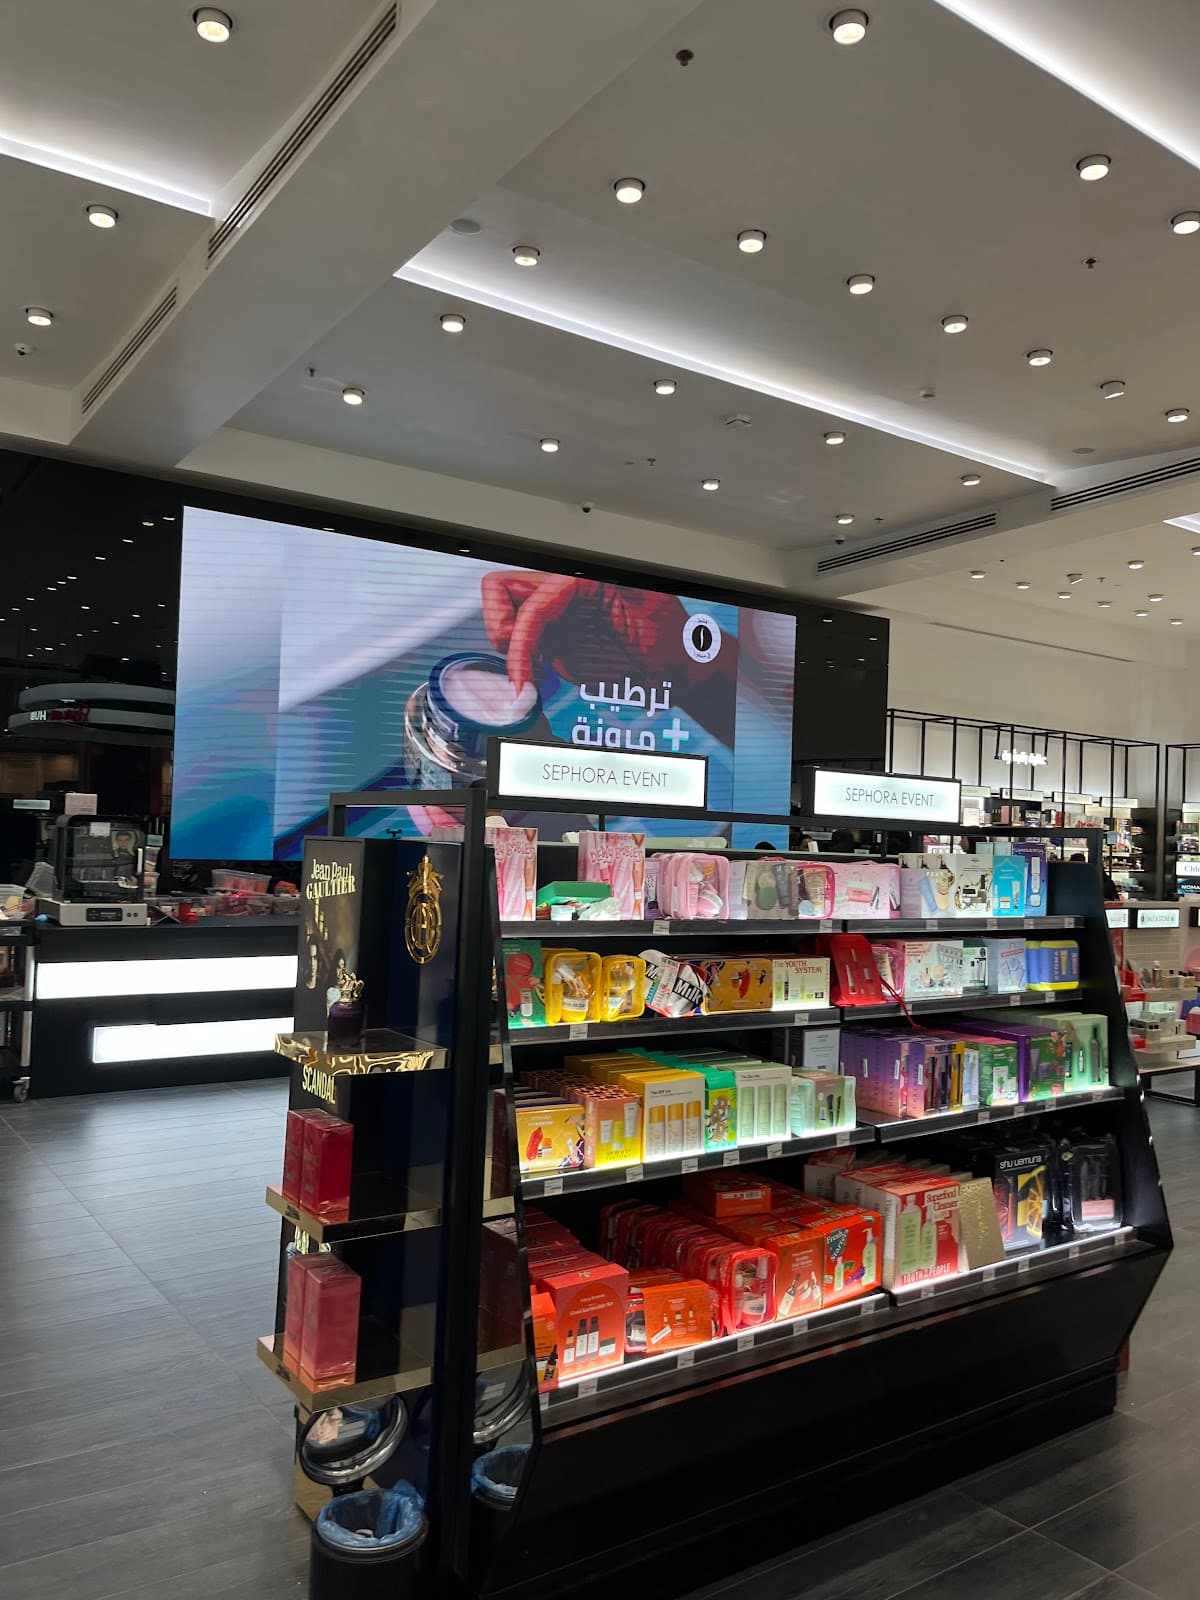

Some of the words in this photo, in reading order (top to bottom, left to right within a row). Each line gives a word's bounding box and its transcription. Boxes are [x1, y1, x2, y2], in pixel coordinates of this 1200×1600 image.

[579, 676, 672, 717] ترطيب
[542, 763, 618, 786] SEPHORA
[622, 768, 669, 788] EVENT
[845, 786, 898, 805] SEPHORA
[901, 791, 934, 807] EVENT
[310, 858, 331, 880] Jean
[331, 861, 352, 881] Paul
[306, 875, 355, 901] GAULTIER
[794, 966, 823, 974] SYSTEM
[674, 979, 702, 1005] Milk
[302, 1066, 336, 1105] SCANDAL
[999, 1160, 1013, 1170] shu
[1014, 1155, 1042, 1167] uemura
